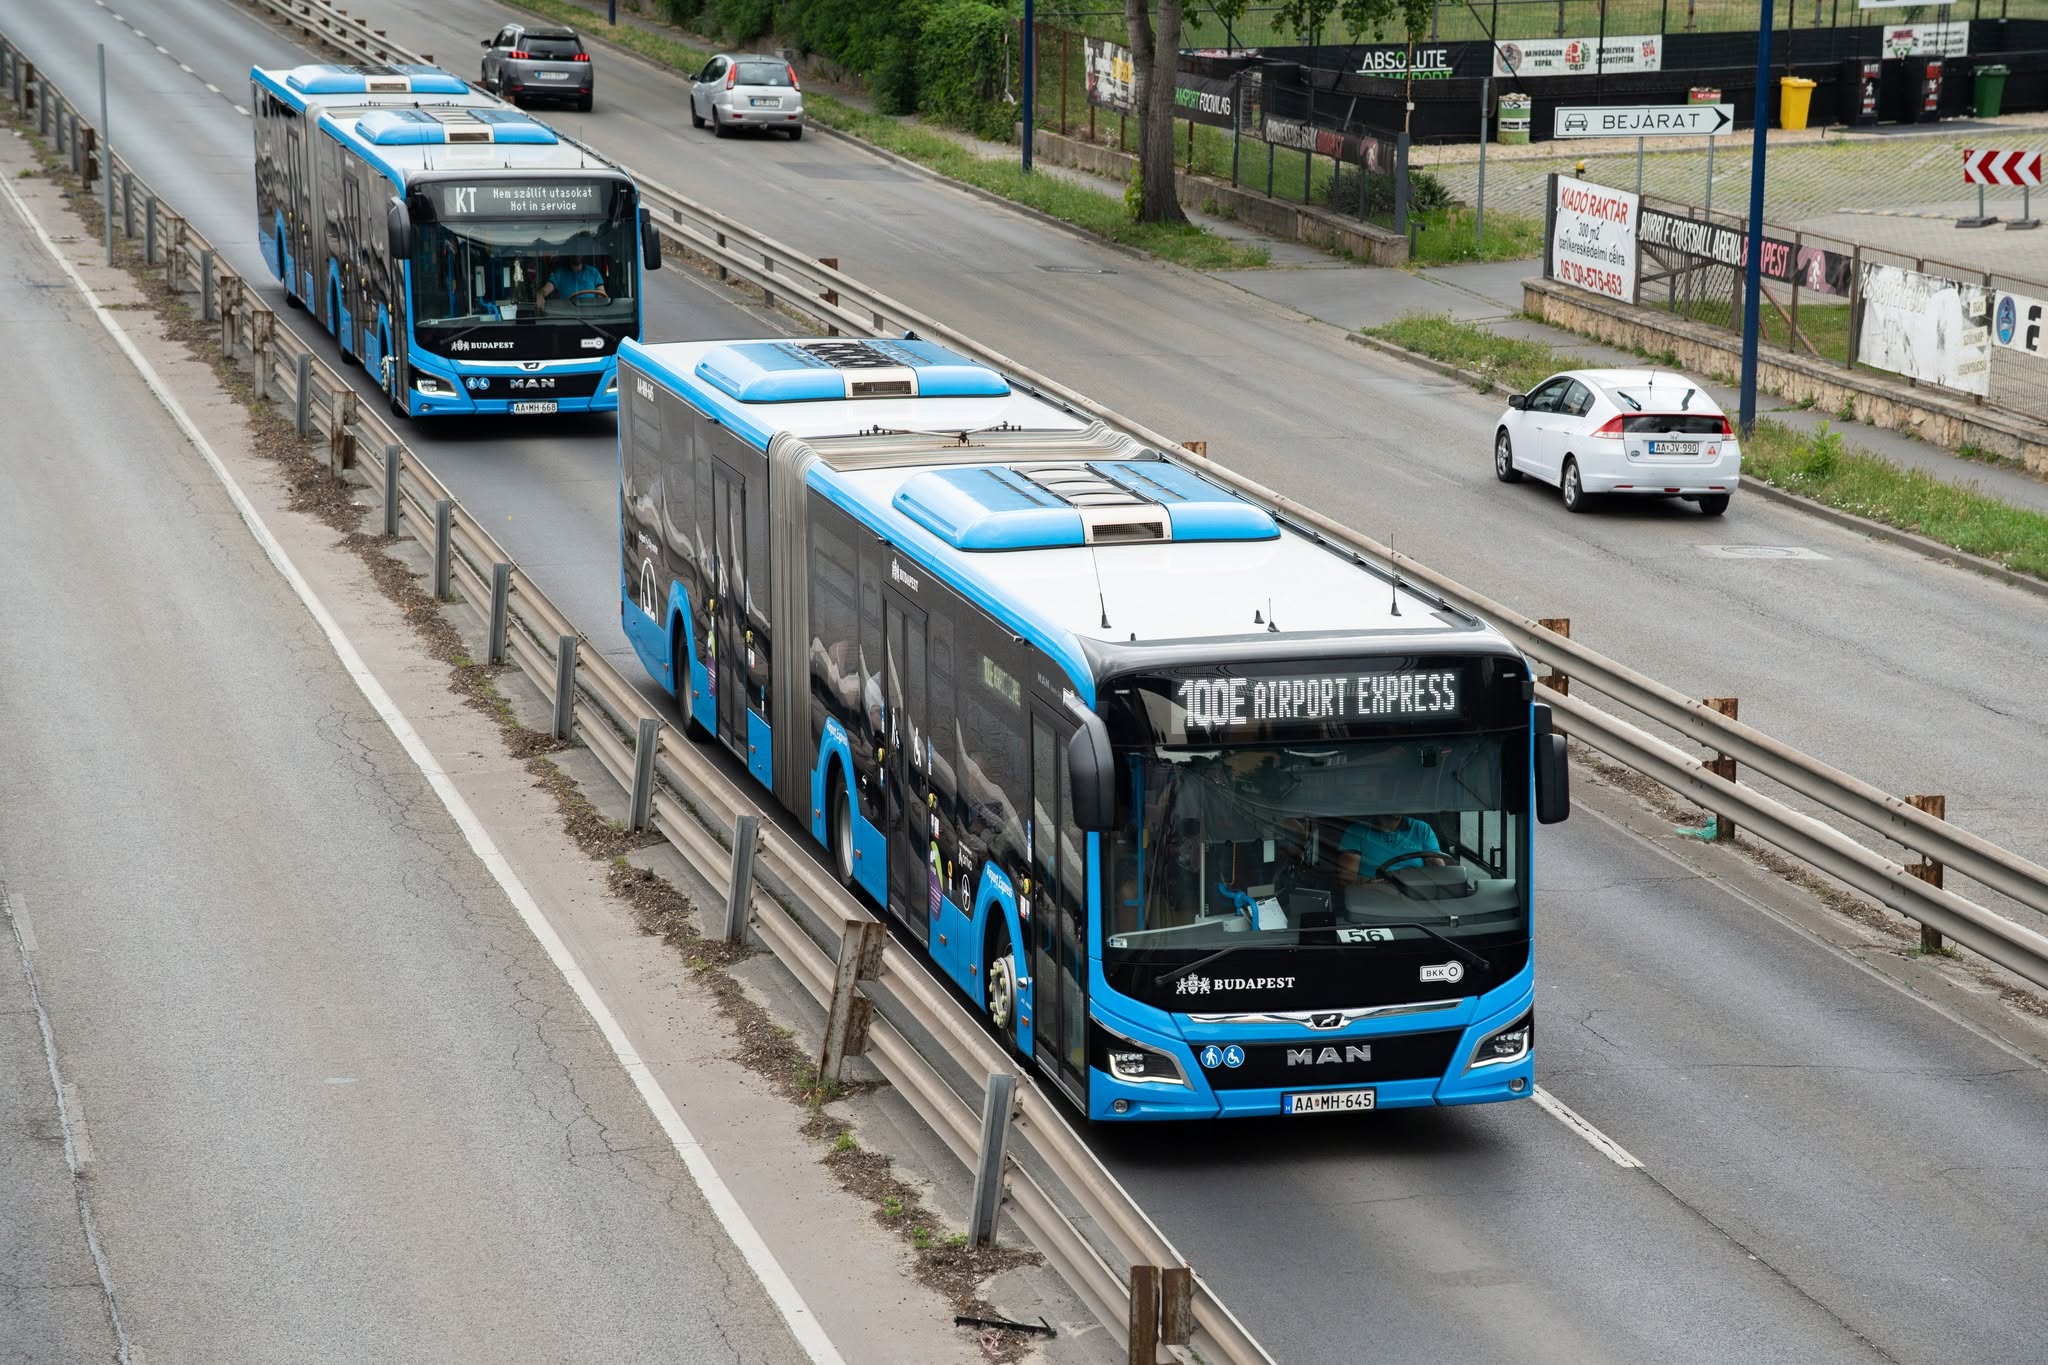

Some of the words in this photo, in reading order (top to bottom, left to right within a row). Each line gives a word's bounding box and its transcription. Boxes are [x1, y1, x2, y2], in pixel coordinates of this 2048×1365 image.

[1602, 109, 1700, 129] BEJÁRAT
[455, 187, 477, 213] KT
[493, 188, 511, 199] Nem
[514, 186, 546, 199] szállít
[549, 187, 592, 198] utasokat
[511, 201, 527, 211] Not
[529, 201, 538, 211] in
[541, 201, 577, 211] service
[1561, 187, 1589, 213] KIADÓ
[1588, 194, 1628, 224] RAKTÁR
[1578, 222, 1589, 238] 300
[1639, 211, 1672, 246] BUBBLE
[1671, 219, 1713, 257] FOOTBALL
[1712, 229, 1741, 266] ARENA
[1741, 236, 1790, 277] BPEST
[1560, 258, 1571, 280] 06
[510, 378, 555, 389] MAN
[1178, 678, 1247, 726] 100E
[1254, 678, 1347, 719] AIRPORT
[1358, 673, 1455, 714] EXPRESS
[1350, 928, 1384, 943] 56
[1426, 968, 1445, 978] BKK
[1214, 976, 1295, 991] BUDAPEST
[1287, 1045, 1372, 1066] MAN
